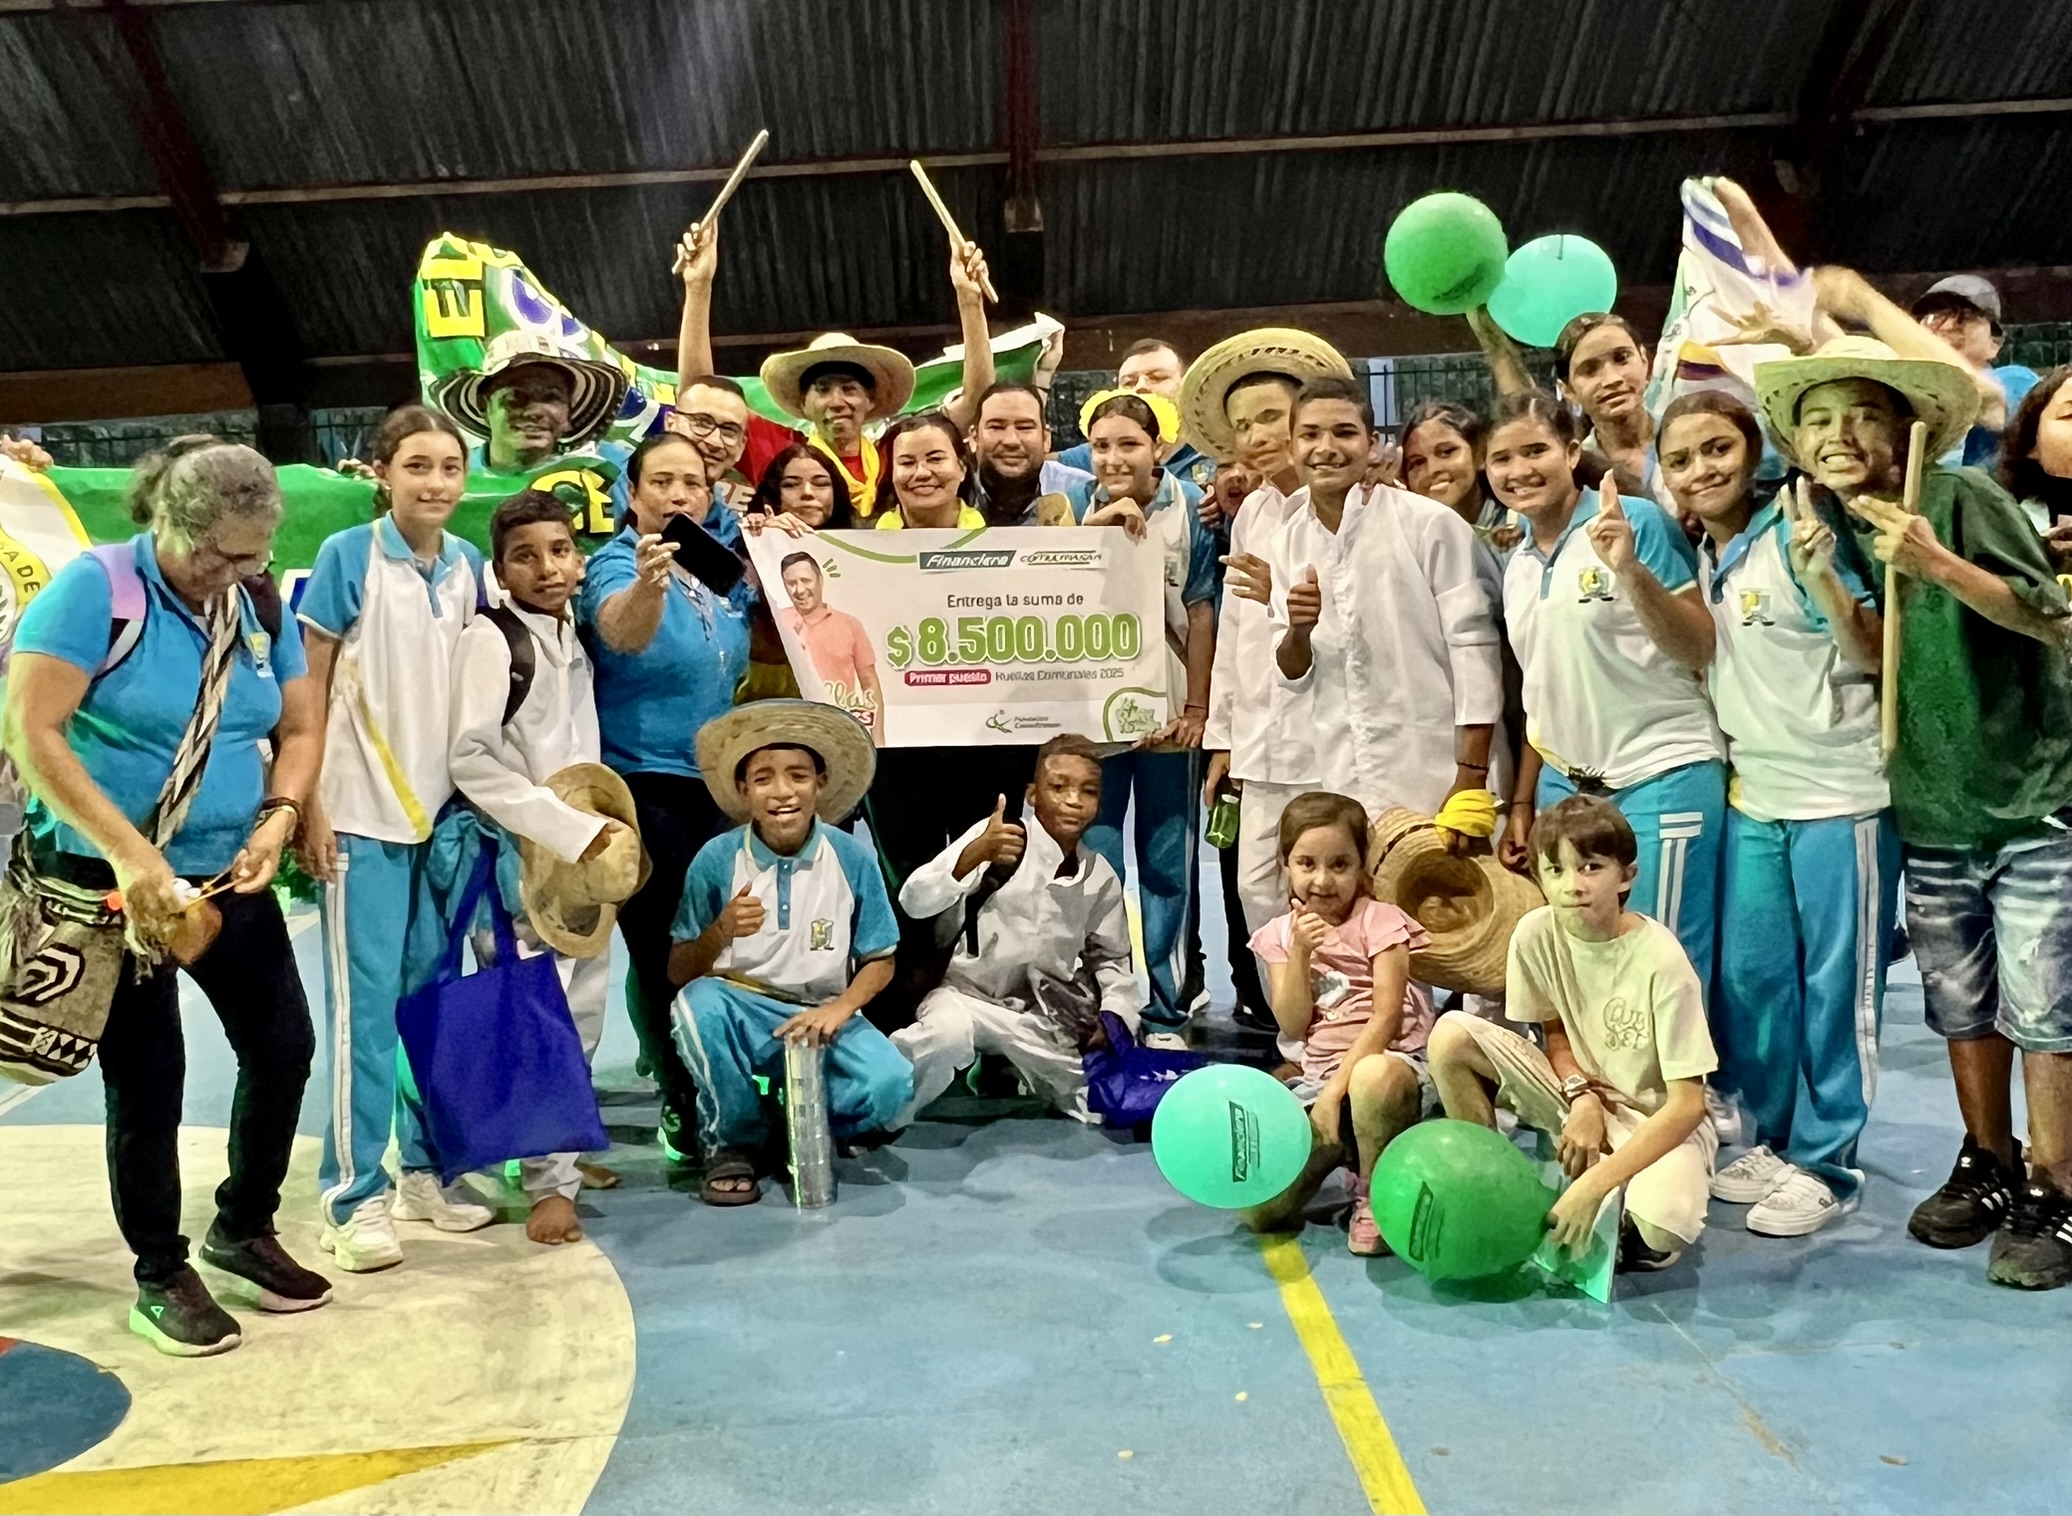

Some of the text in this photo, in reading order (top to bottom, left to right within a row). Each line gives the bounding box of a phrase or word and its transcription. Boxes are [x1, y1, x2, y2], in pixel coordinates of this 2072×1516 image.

[925, 554, 1009, 568] Financiera
[947, 593, 1084, 610] Entrega la suma de
